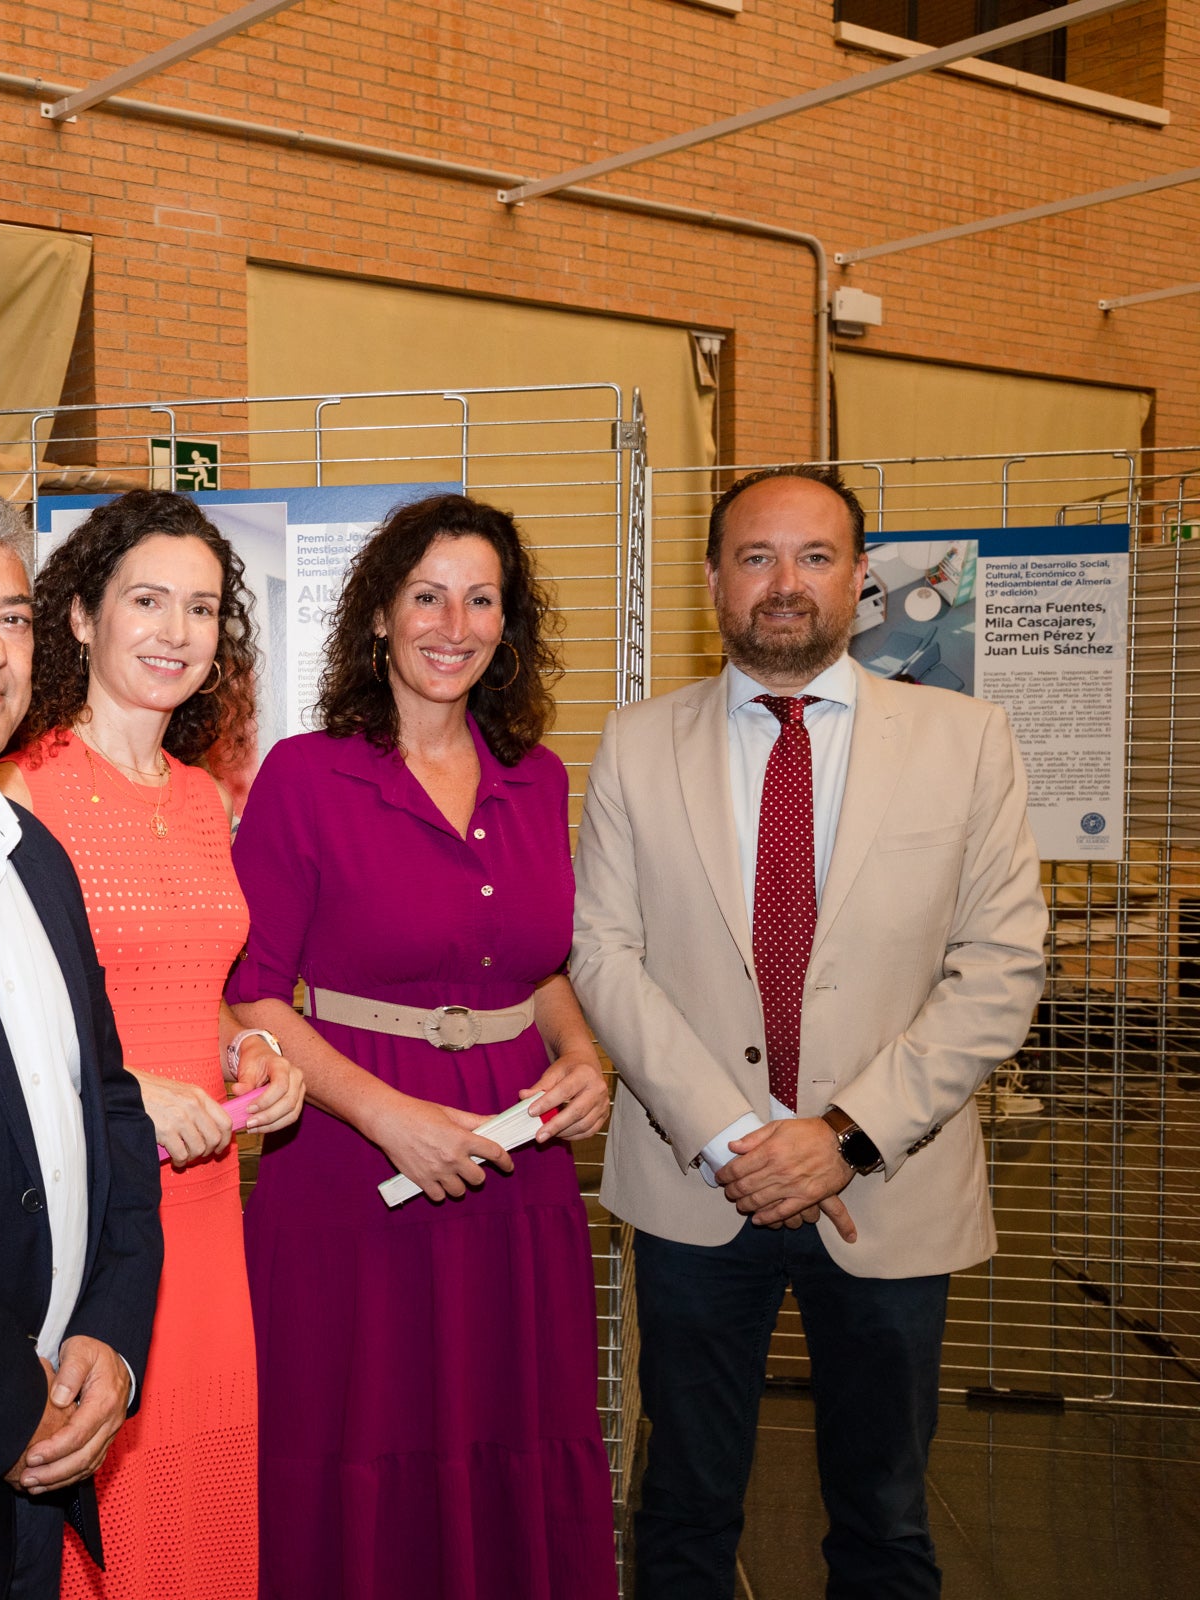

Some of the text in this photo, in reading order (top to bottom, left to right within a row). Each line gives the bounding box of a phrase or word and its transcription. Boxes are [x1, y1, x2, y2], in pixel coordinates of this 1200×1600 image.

[297, 534, 334, 543] Premio
[297, 556, 341, 566] Sociales
[1020, 562, 1029, 570] al
[1030, 561, 1078, 569] Desarrollo
[1079, 560, 1110, 568] Social,
[985, 571, 1023, 580] Cultural,
[1025, 570, 1076, 578] Económico
[1000, 588, 1038, 597] edición)
[985, 602, 1106, 614] Encarna Fuentes,
[985, 616, 1096, 629] Mila Cascajares,
[984, 630, 1096, 642] Carmen Pérez y
[984, 643, 1113, 656] Juan Luis Sánchez
